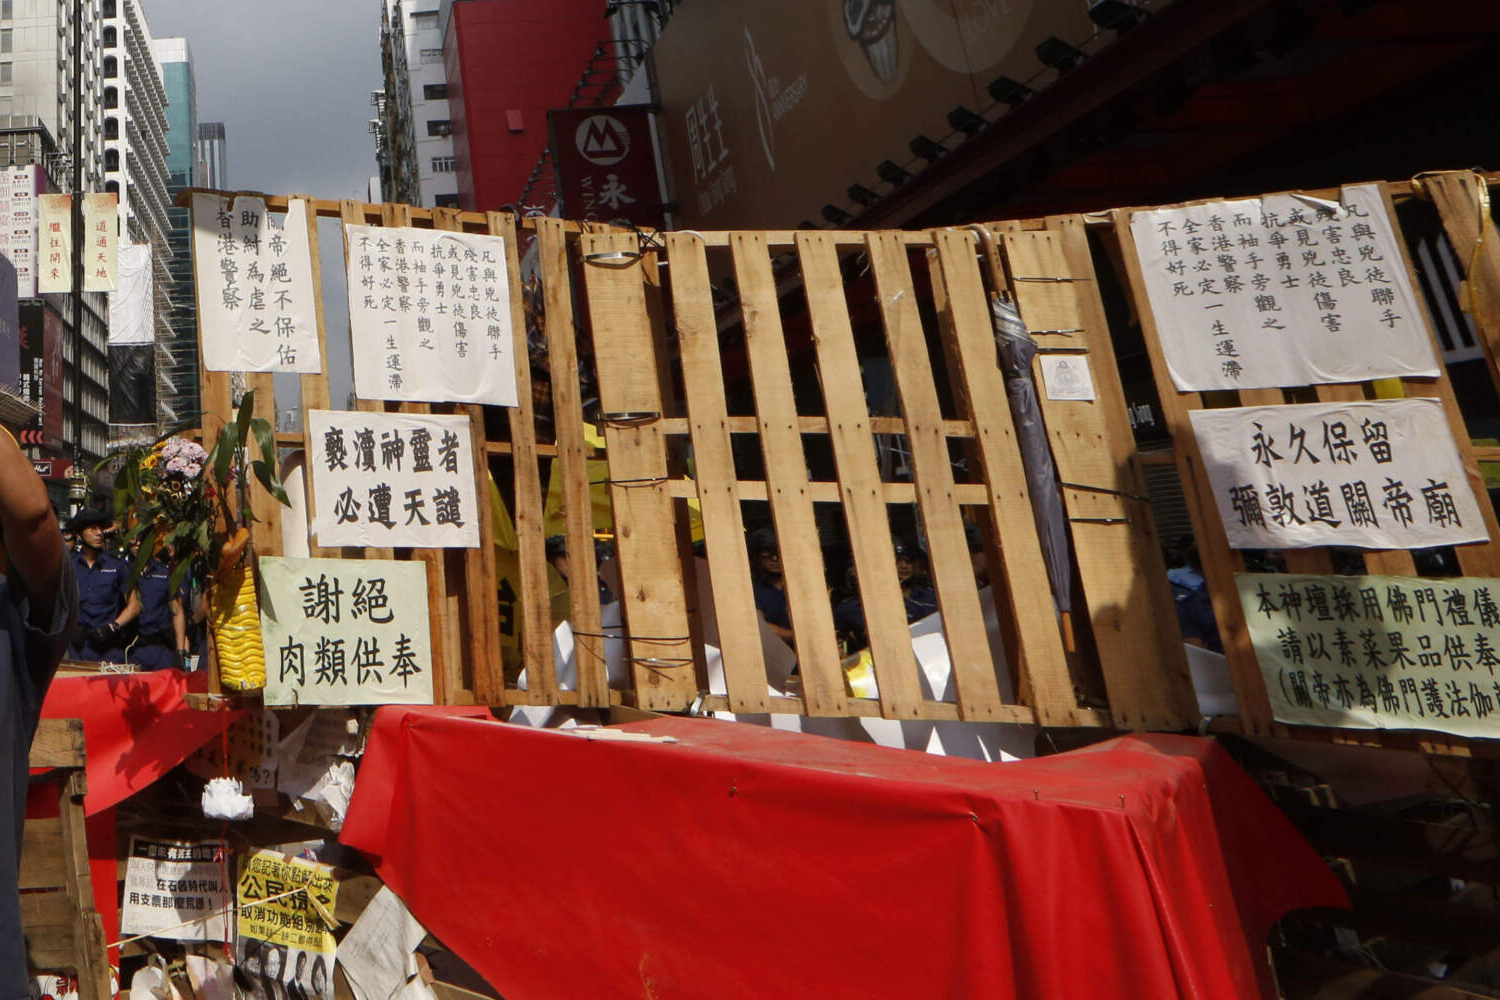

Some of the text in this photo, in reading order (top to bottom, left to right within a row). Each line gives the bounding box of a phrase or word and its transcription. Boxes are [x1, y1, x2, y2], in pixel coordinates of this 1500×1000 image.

[215, 207, 243, 312] 香港警察
[240, 210, 271, 335] 助紂為虐之
[358, 236, 378, 310] 不得好死
[394, 238, 413, 313] 香港警察
[1156, 221, 1194, 298] 不得好死
[1207, 214, 1245, 294] 香港警察
[1232, 213, 1286, 330] 而袖手旁觀之
[1316, 206, 1362, 287] 殘害忠良
[411, 241, 435, 350] 而袖手旁觀之
[463, 248, 484, 321] 殘害忠良
[323, 426, 461, 475] 褻瀆神靈者
[1250, 417, 1393, 468] 永久保留
[333, 482, 466, 530] 必遭天譴
[1228, 477, 1462, 530] 彌敦道關帝廟
[298, 573, 395, 625] 謝絕
[1256, 582, 1500, 629] 本神壇採用佛門禮儀
[278, 632, 423, 689] 肉類供奉
[1276, 626, 1500, 676] 請以素菜果品供奉
[1278, 667, 1500, 719] (關帝亦為佛門護法伽
